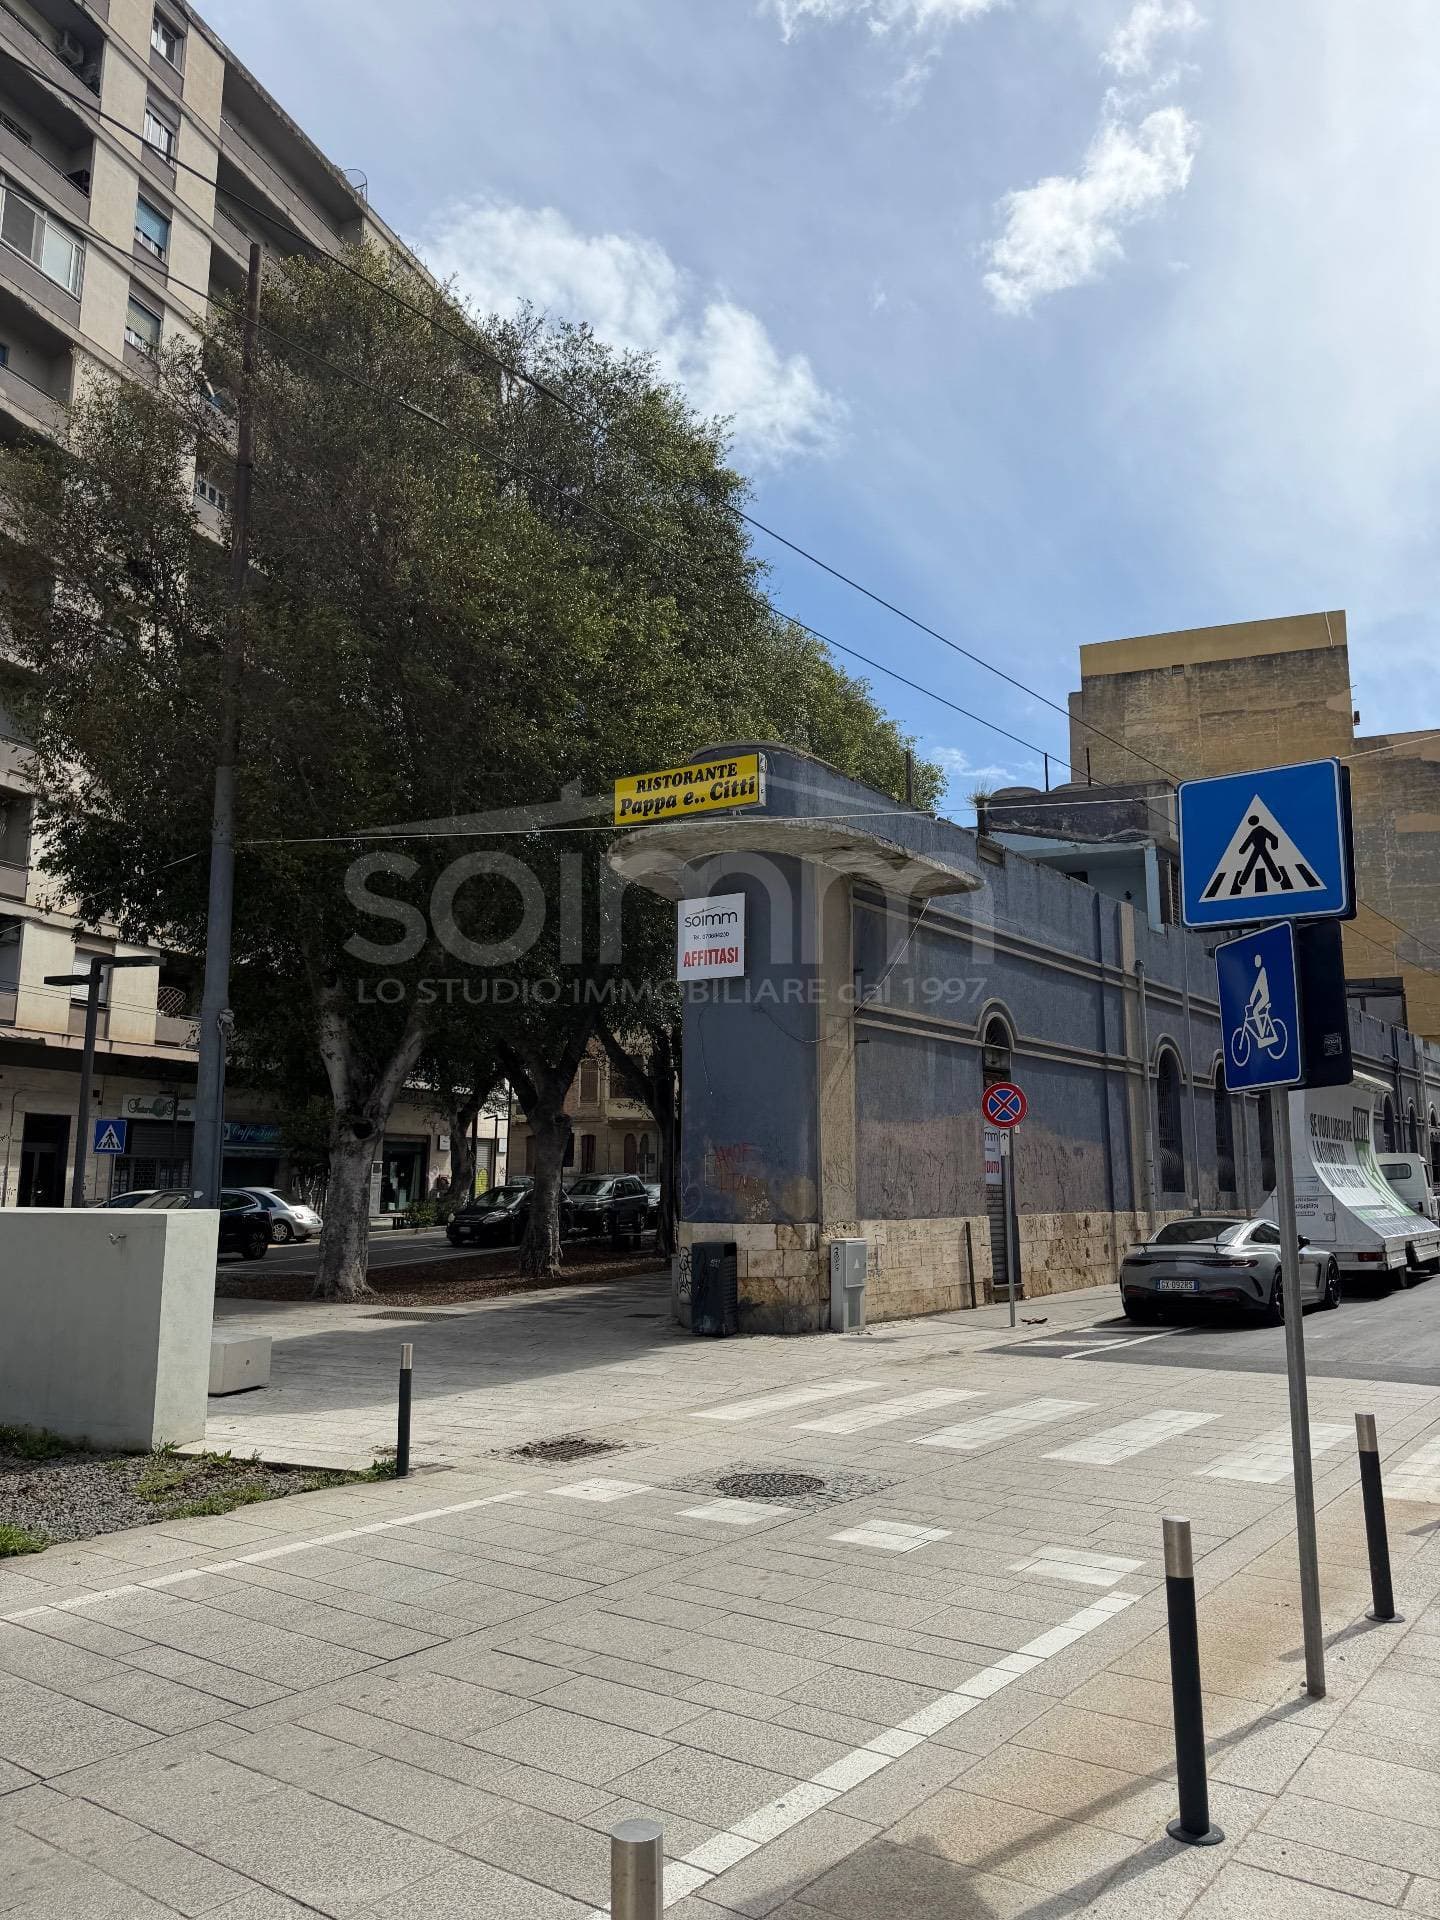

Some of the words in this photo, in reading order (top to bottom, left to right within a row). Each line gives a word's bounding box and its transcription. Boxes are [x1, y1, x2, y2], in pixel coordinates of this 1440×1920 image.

[636, 762, 737, 793] RISTORANTE
[619, 793, 677, 816] Pappa
[709, 775, 755, 801] Citti
[684, 911, 738, 928] soimm
[683, 946, 739, 968] AFFITTASI
